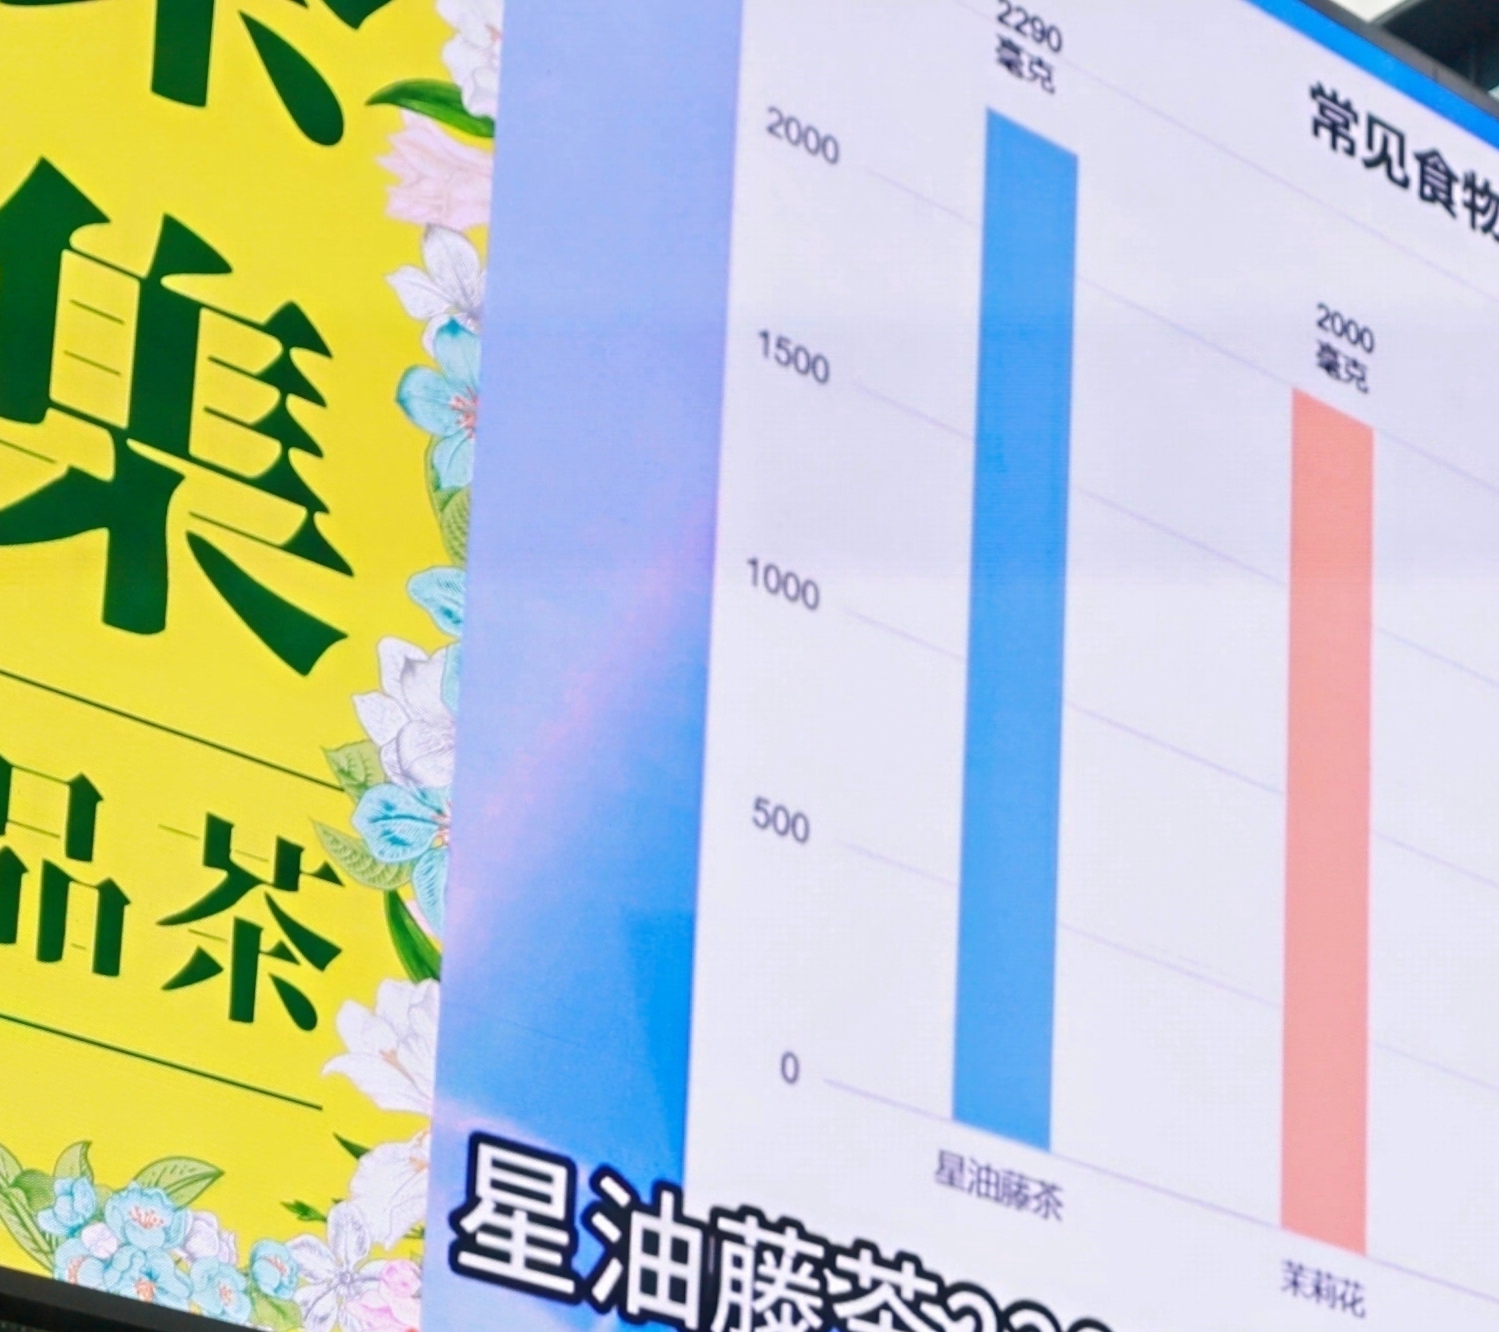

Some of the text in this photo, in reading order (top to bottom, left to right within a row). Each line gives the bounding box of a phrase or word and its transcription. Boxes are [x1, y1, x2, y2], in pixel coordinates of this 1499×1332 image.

[997, 0, 1062, 53] 2290
[995, 33, 1056, 94] 毫克
[766, 107, 841, 166] 2000
[1316, 303, 1375, 354] 2000
[757, 329, 831, 385] 1500
[1315, 339, 1369, 394] 毫克
[747, 557, 820, 611] 1000
[752, 796, 810, 843] 500
[780, 1050, 801, 1086] 0
[934, 1147, 1065, 1224] 星油藤茶
[1280, 1257, 1367, 1320] 茉莉花
